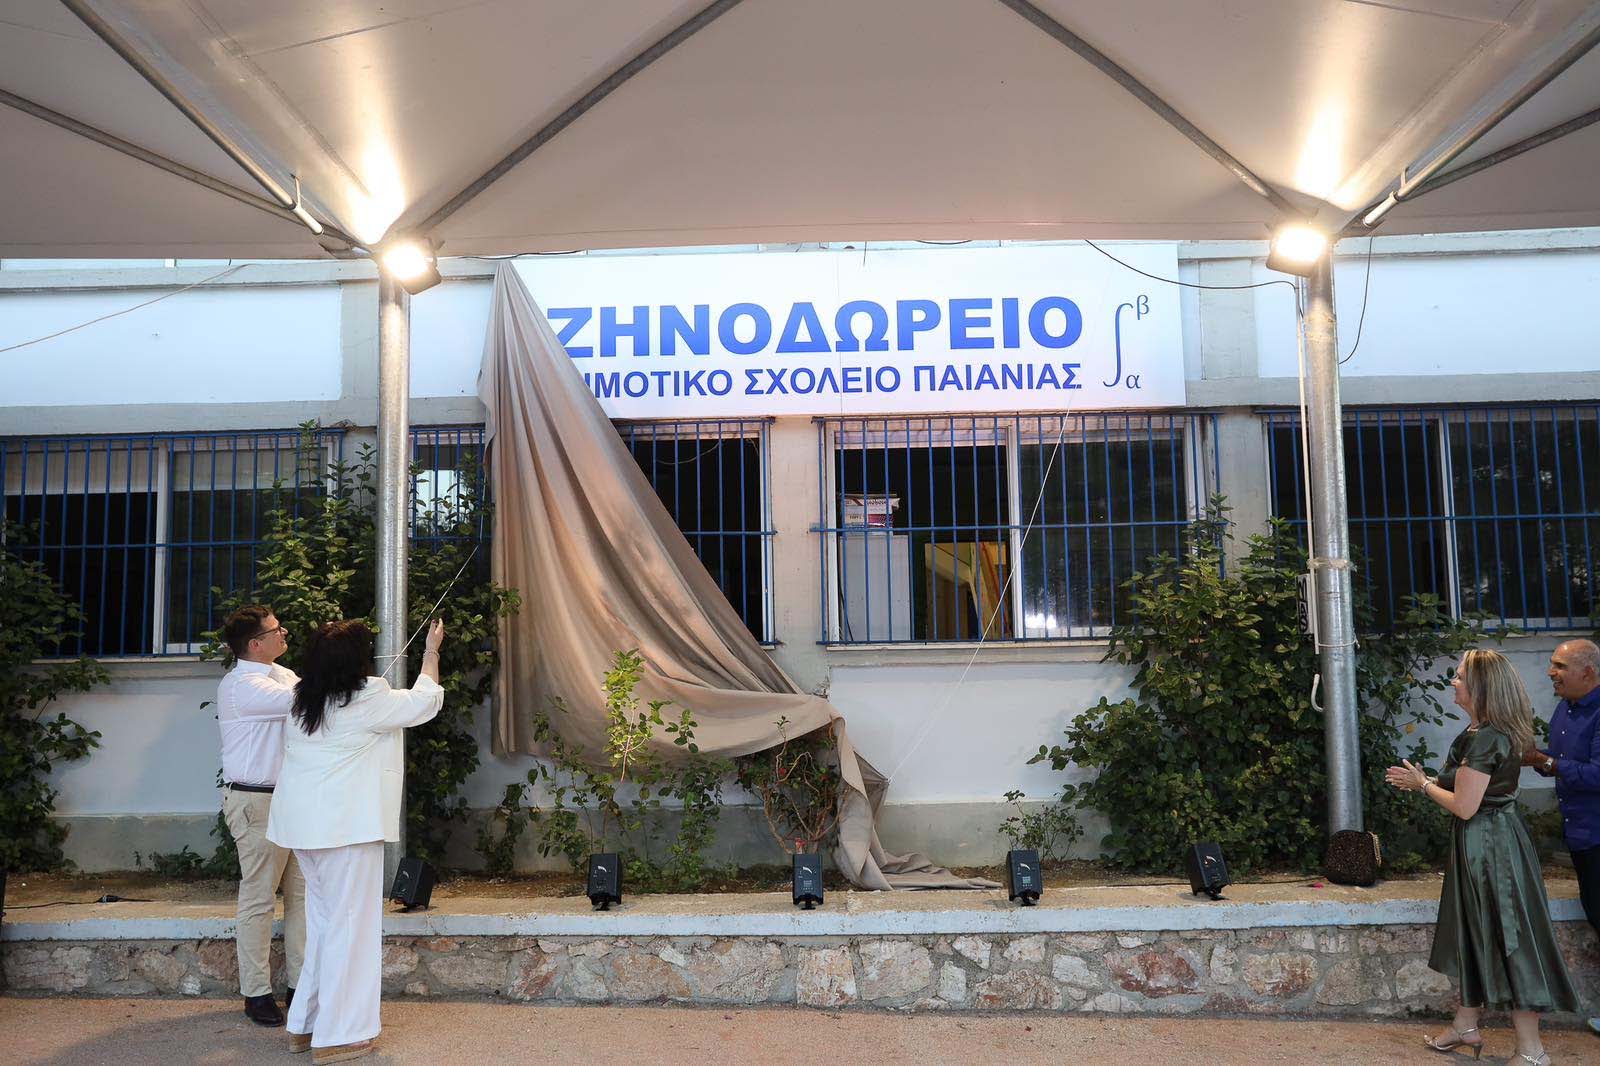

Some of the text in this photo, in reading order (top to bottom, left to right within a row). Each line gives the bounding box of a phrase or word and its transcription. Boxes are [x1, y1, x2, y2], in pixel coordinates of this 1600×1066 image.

[546, 295, 1083, 359] ΖΗΝΟΔΩΡΕΙΟ
[584, 362, 1083, 399] ΜΟΤΙΚΟ ΣΧΟΛΕΙΟ ΠΑΙΑΝΙΑΣ
